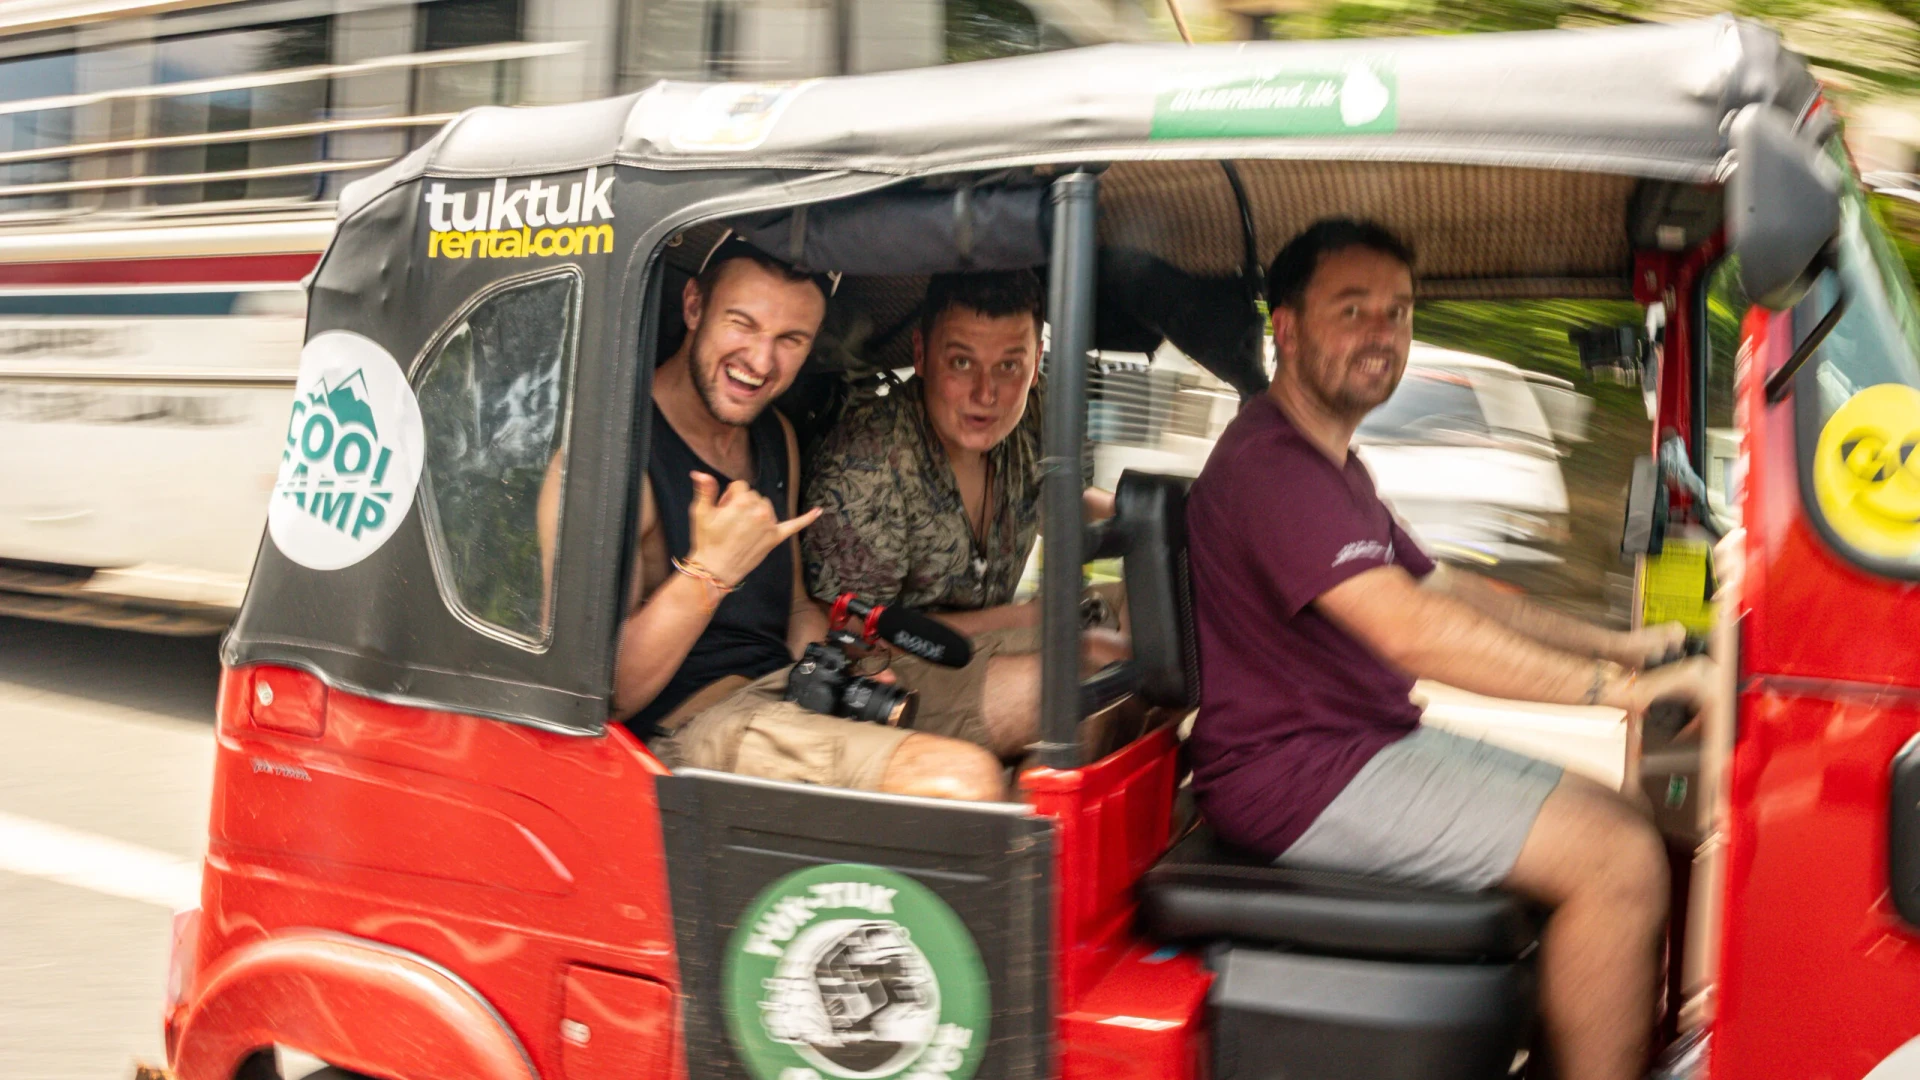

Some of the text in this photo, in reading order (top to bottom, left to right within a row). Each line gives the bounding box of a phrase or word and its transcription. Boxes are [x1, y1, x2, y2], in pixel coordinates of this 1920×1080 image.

[425, 167, 616, 232] tuktuk
[428, 224, 614, 259] rental.com
[280, 450, 390, 541] AMP
